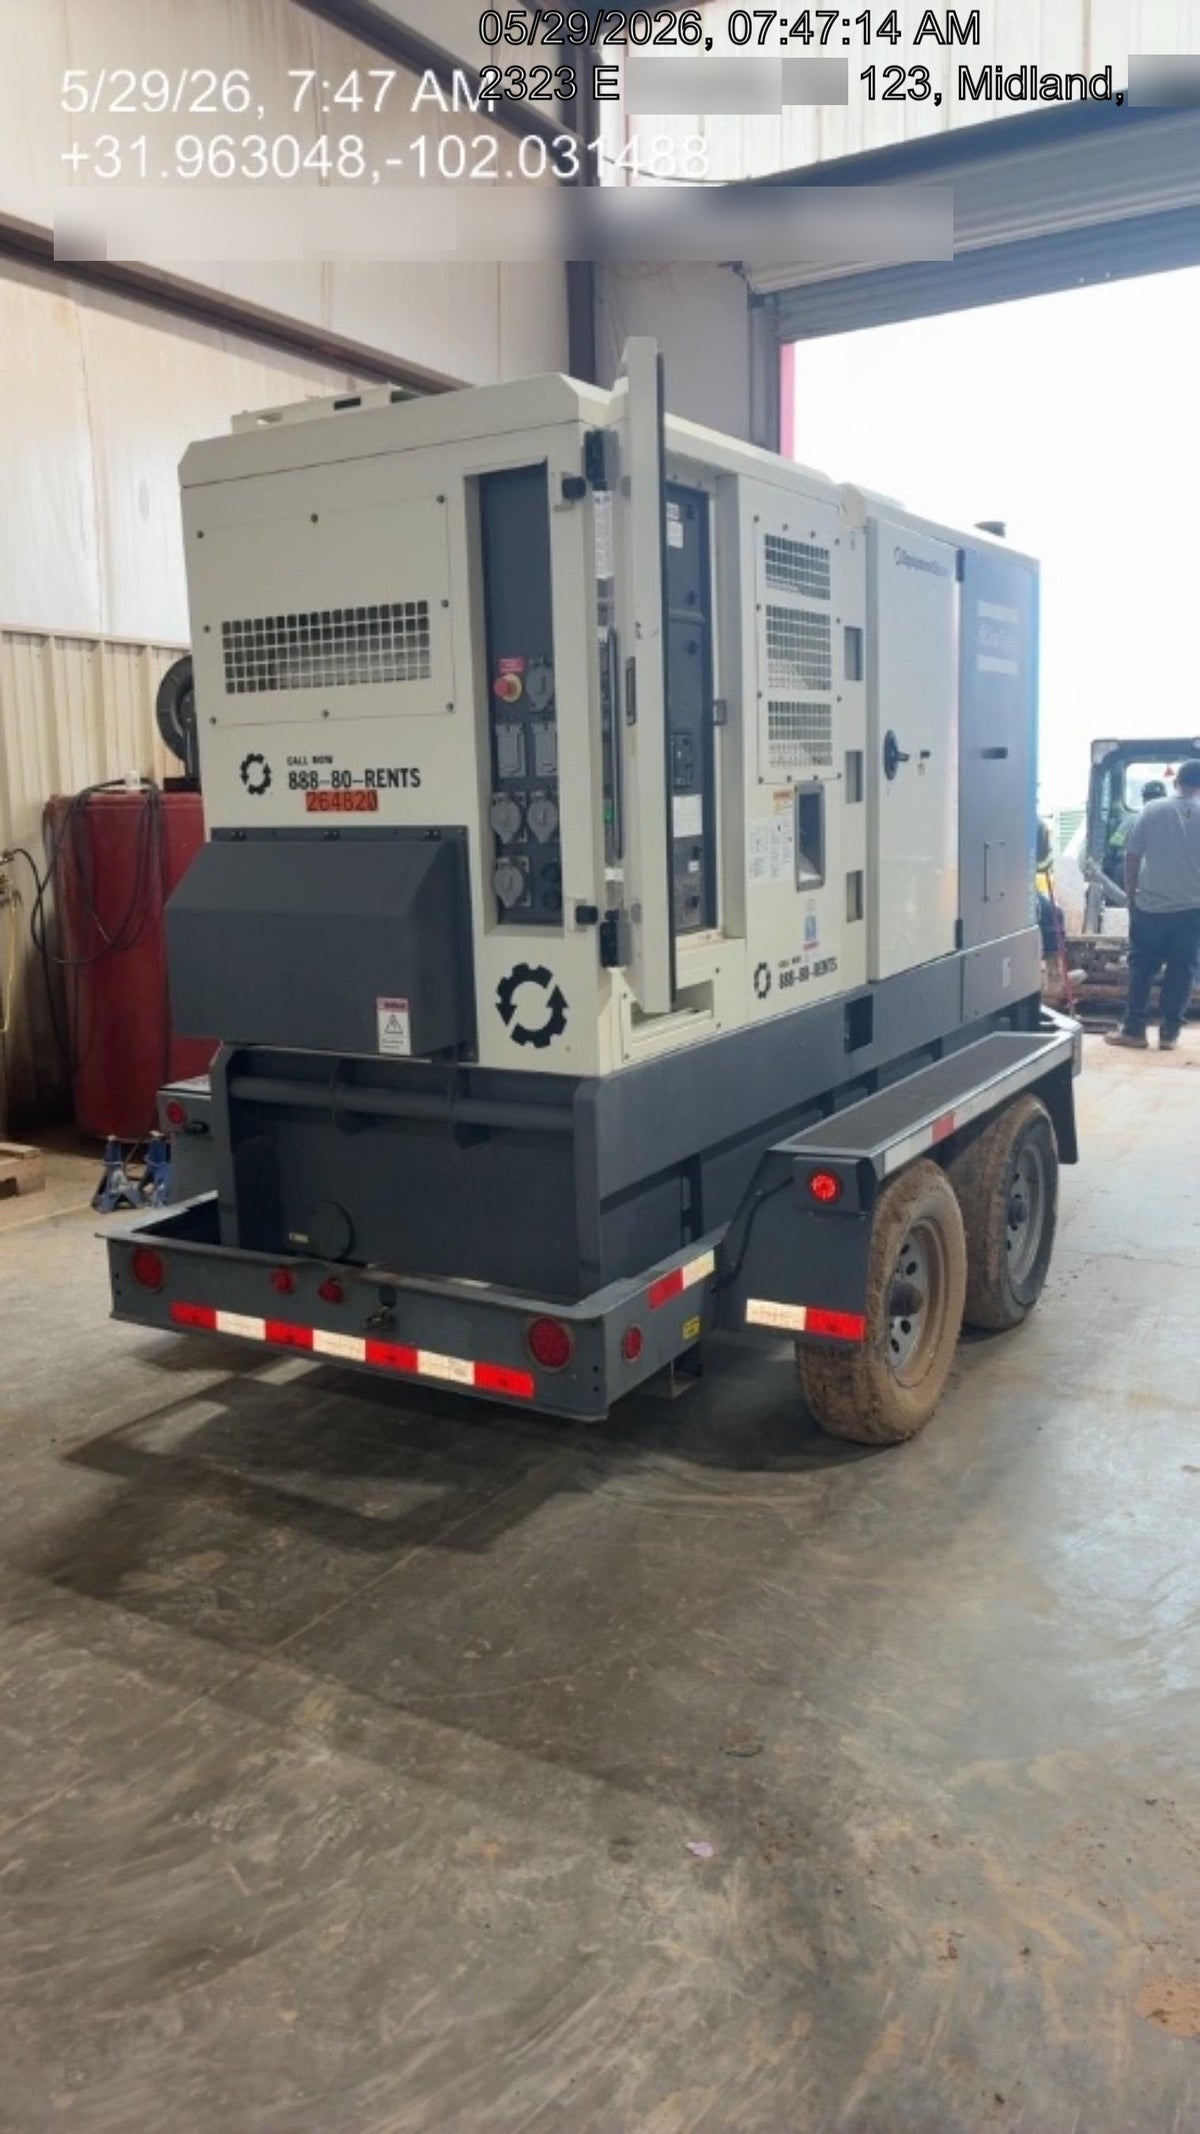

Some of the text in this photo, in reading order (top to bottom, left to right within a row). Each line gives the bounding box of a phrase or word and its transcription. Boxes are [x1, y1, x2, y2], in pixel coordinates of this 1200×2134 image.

[287, 755, 333, 766] CALL NOW
[288, 768, 421, 790] 888-80-RENTS
[307, 790, 378, 811] 264820
